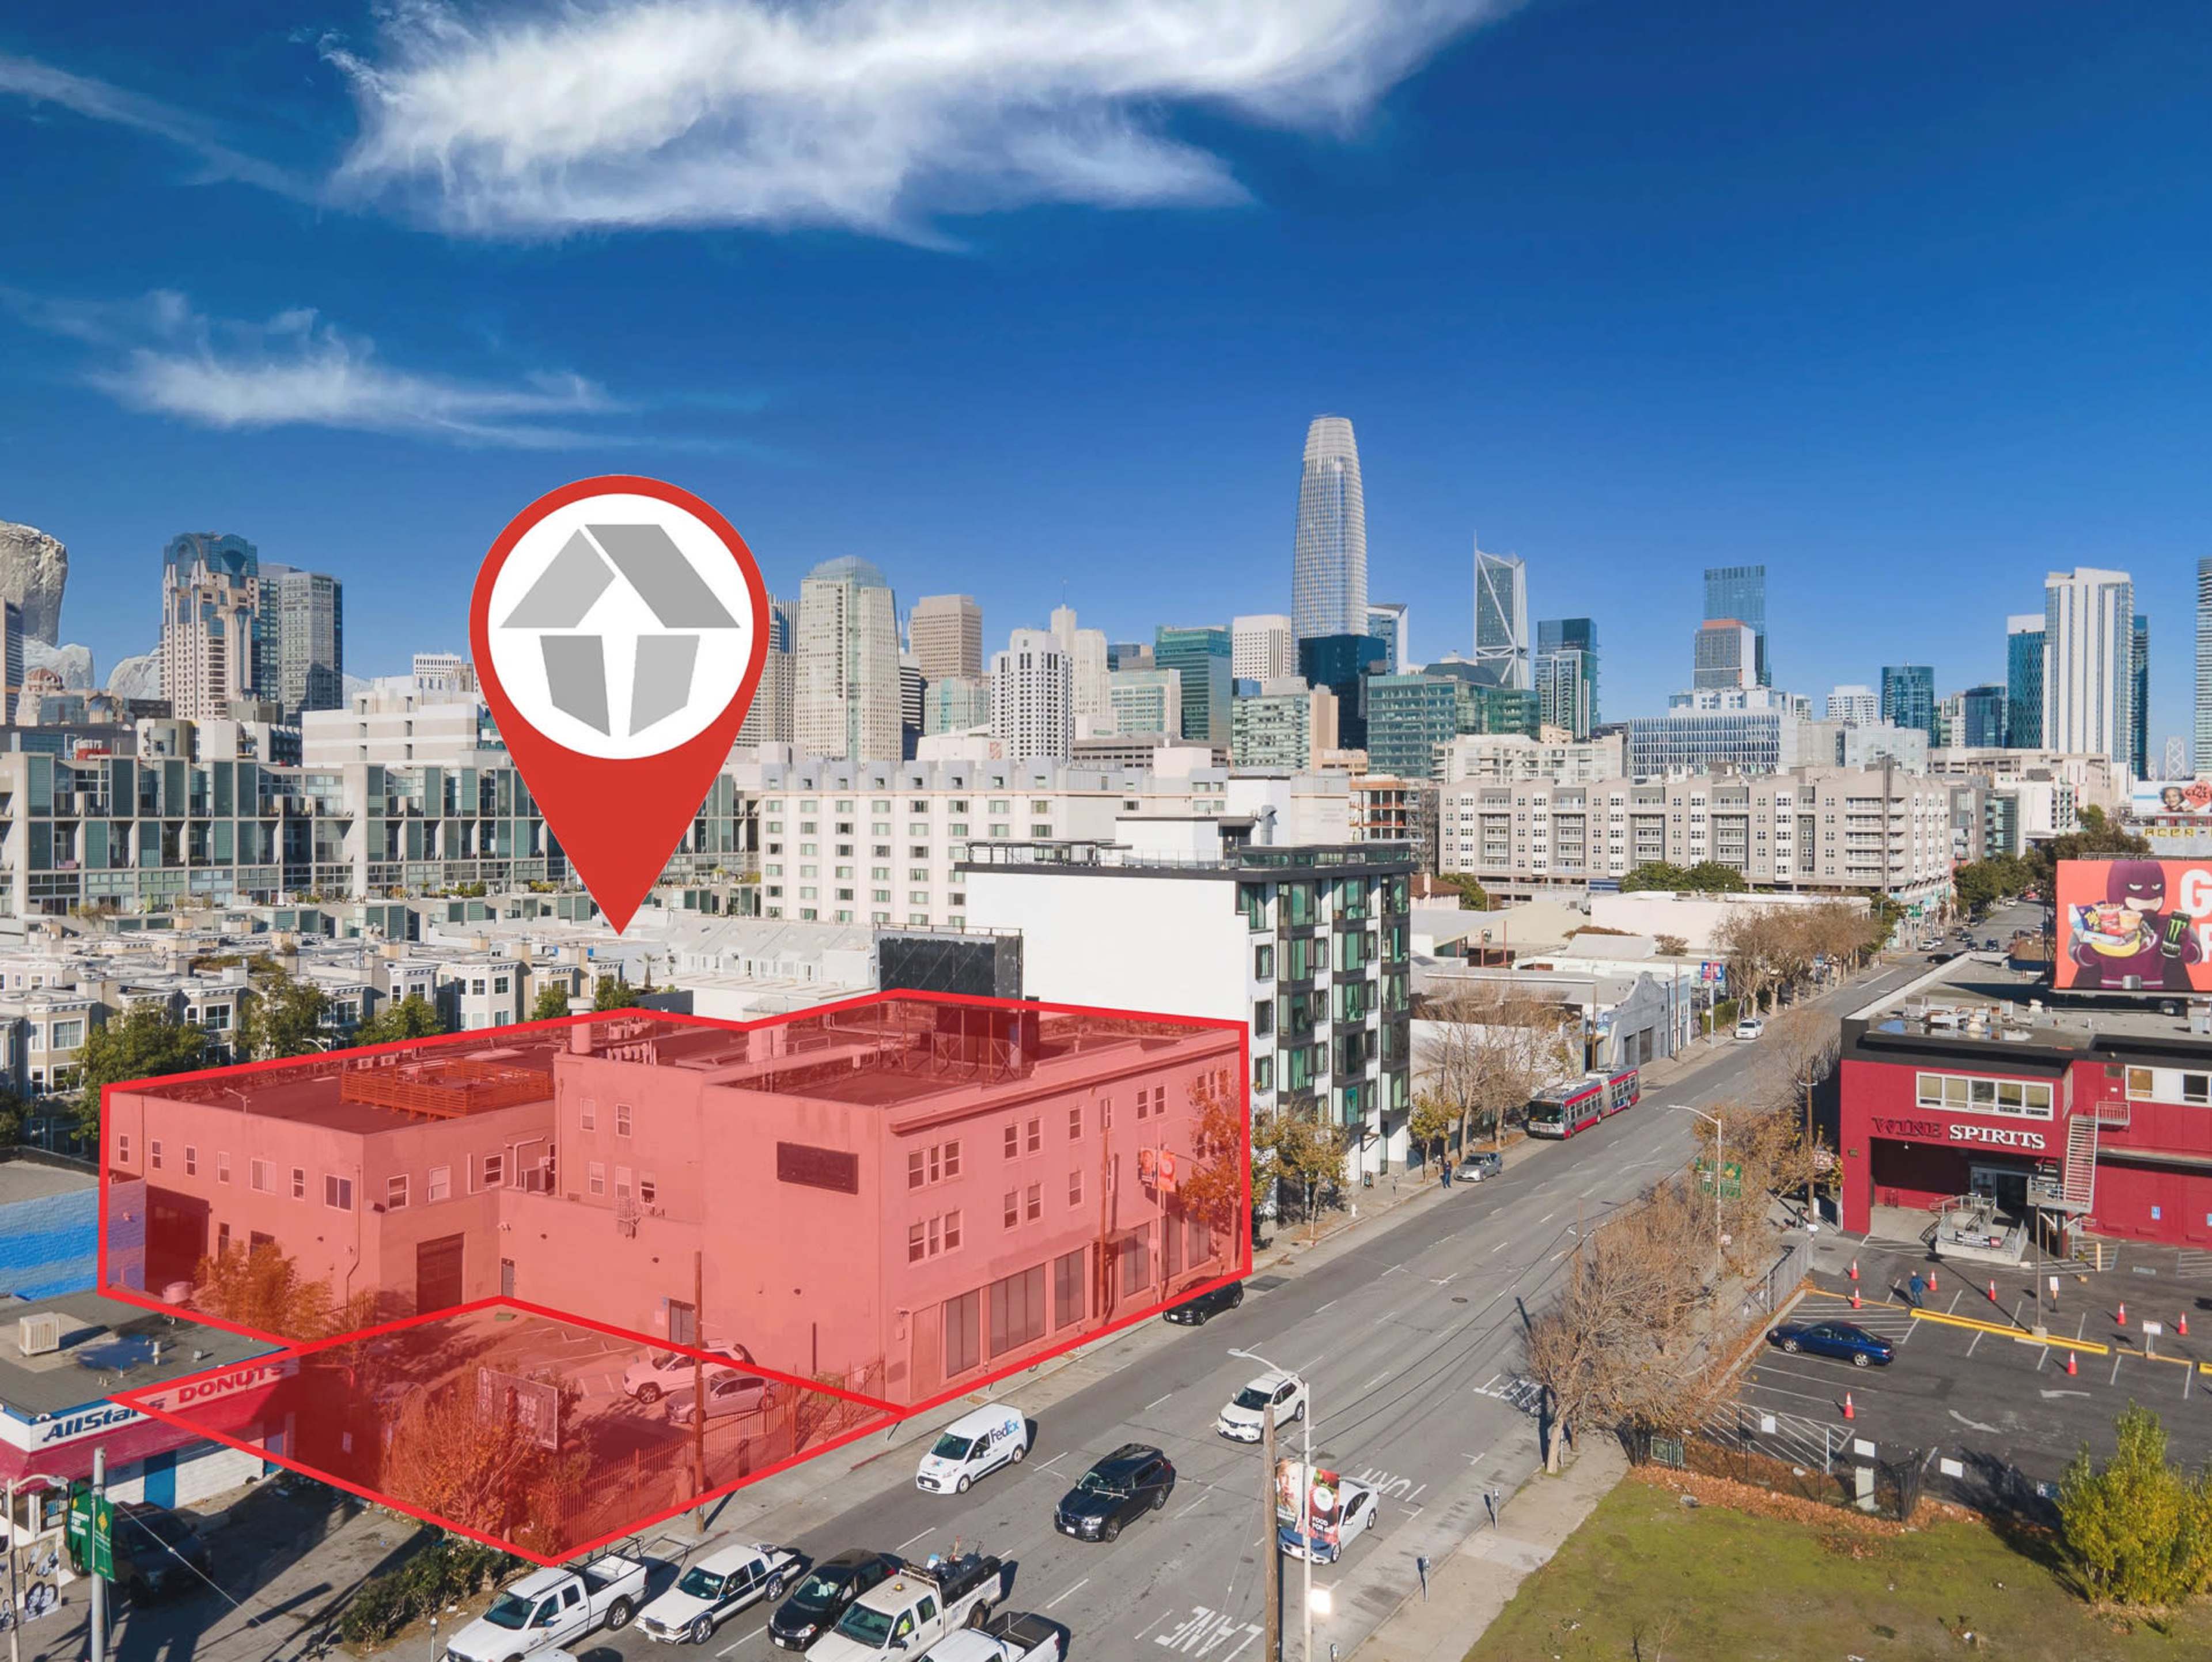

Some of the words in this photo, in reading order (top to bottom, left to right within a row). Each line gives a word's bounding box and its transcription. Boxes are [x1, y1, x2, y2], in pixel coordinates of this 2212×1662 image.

[1872, 1116, 1942, 1138] WINE
[1949, 1124, 2046, 1149] SPIRITS
[178, 1366, 285, 1404] DONUTS
[990, 1419, 1020, 1444] FedEx
[1312, 1516, 1328, 1527] FOOD
